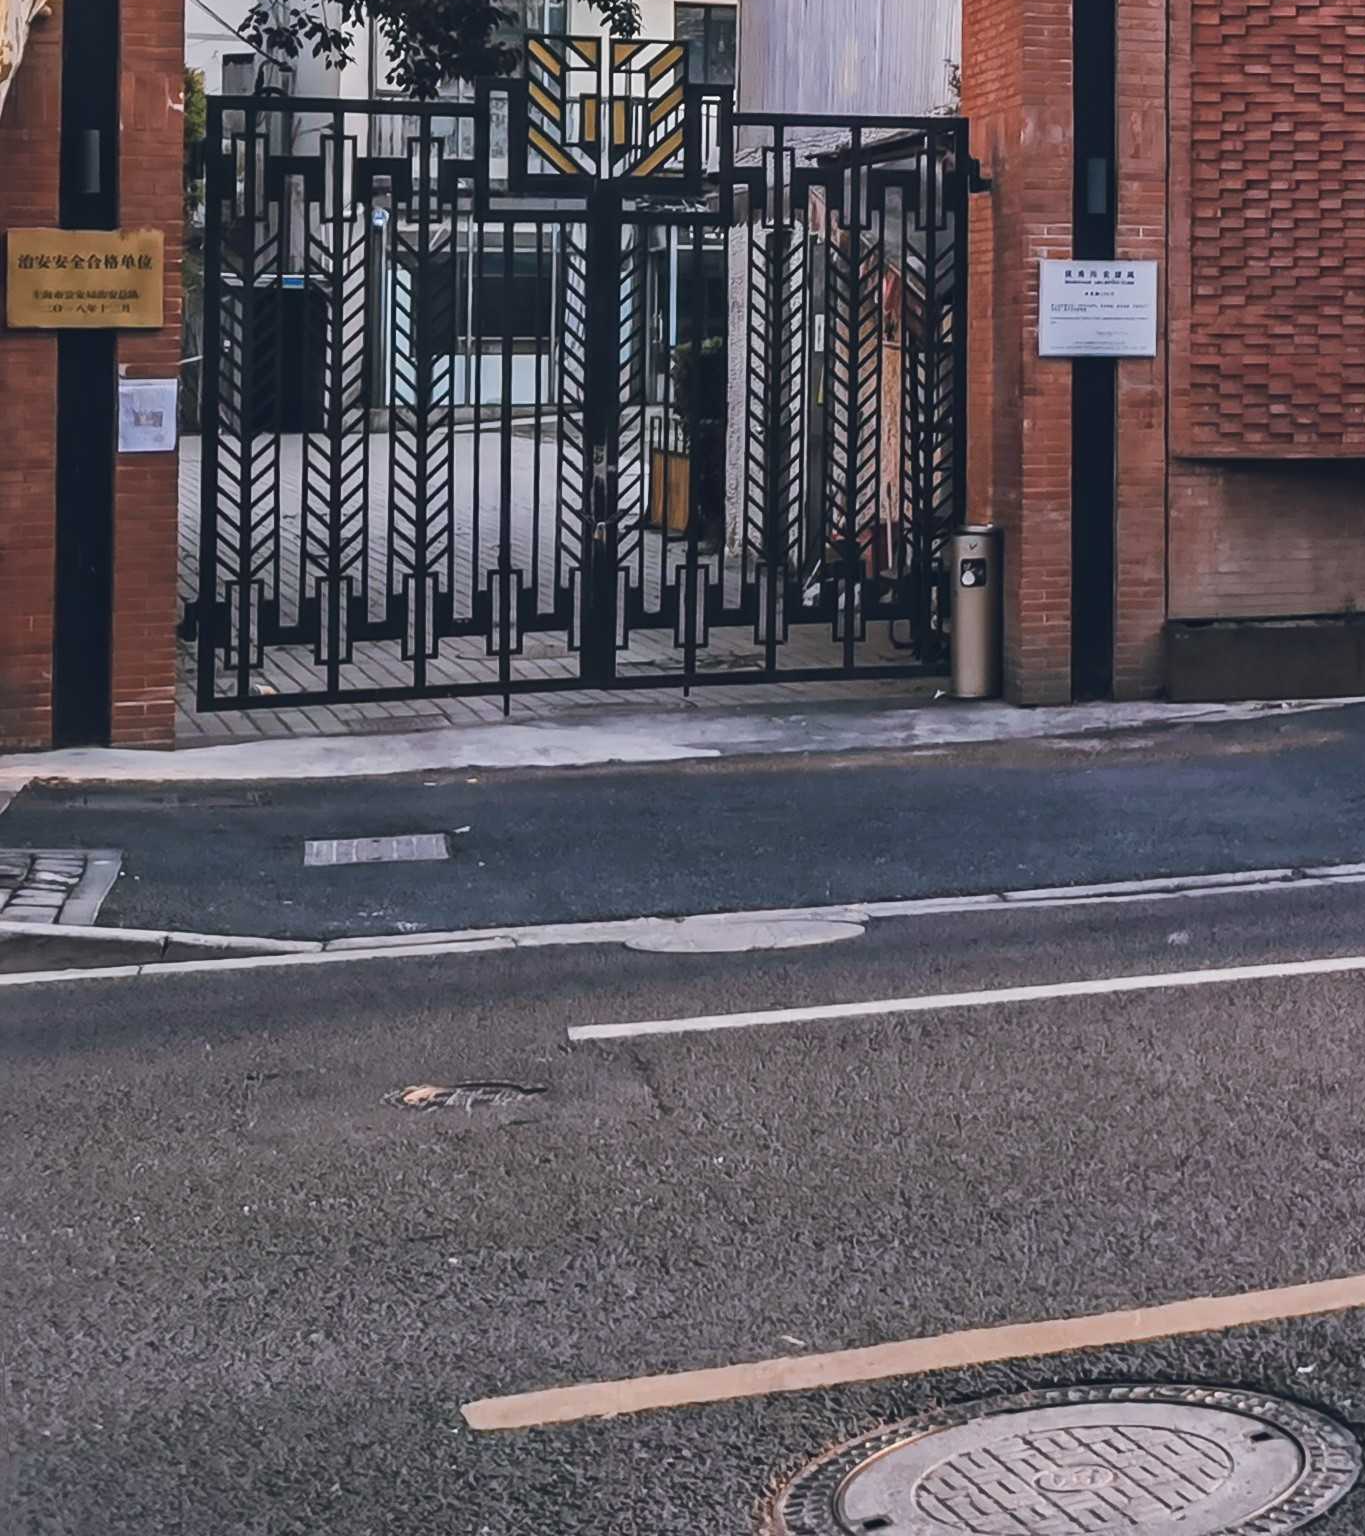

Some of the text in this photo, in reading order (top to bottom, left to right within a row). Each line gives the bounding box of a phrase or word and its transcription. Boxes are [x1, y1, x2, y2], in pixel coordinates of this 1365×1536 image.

[17, 253, 153, 270] 治安安全合格单位
